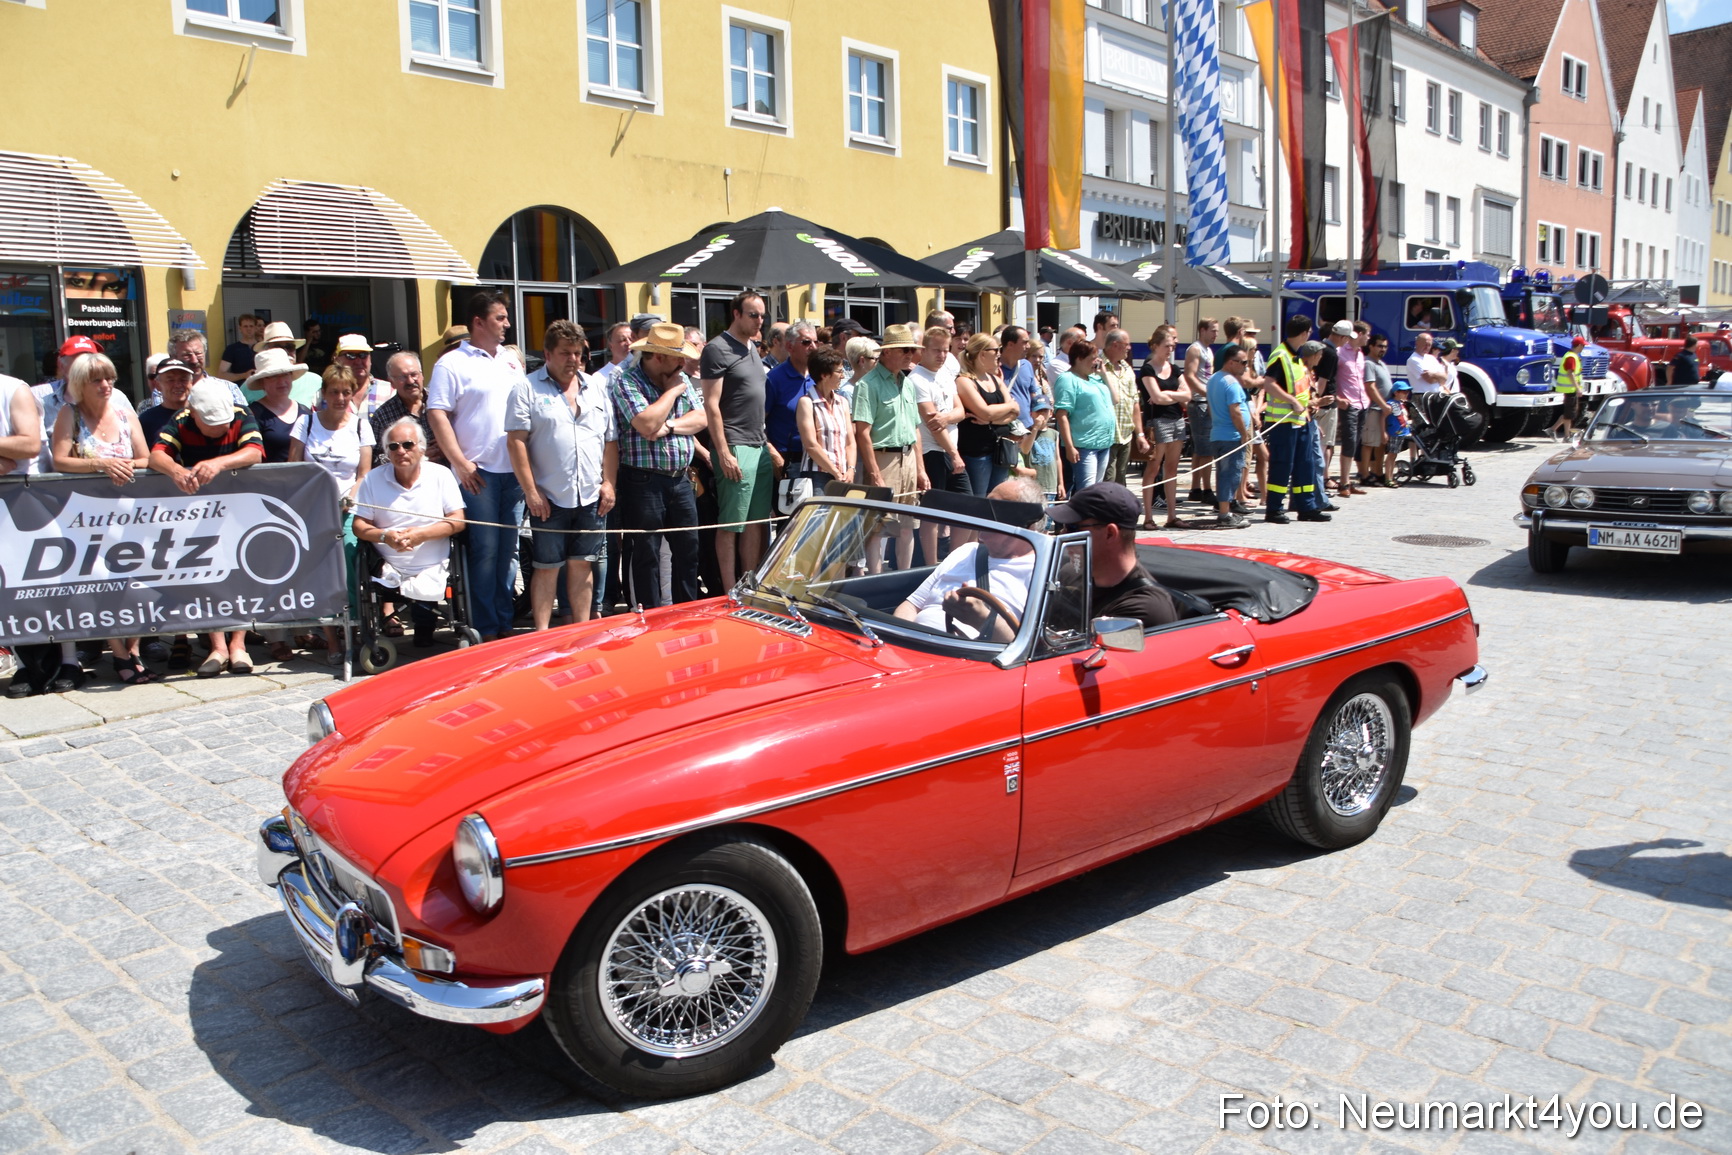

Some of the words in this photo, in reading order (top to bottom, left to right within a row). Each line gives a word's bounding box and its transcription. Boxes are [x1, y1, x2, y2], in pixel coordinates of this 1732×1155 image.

[81, 304, 123, 313] Passbilder
[992, 304, 1002, 315] 24
[67, 317, 138, 329] Bewerbungsbilder
[66, 501, 226, 530] Autoklassik
[1597, 531, 1614, 544] NM
[1624, 533, 1640, 546] AX
[1644, 534, 1678, 548] 462H
[22, 528, 220, 581] Dietz
[15, 581, 127, 600] BREITENBRUNN
